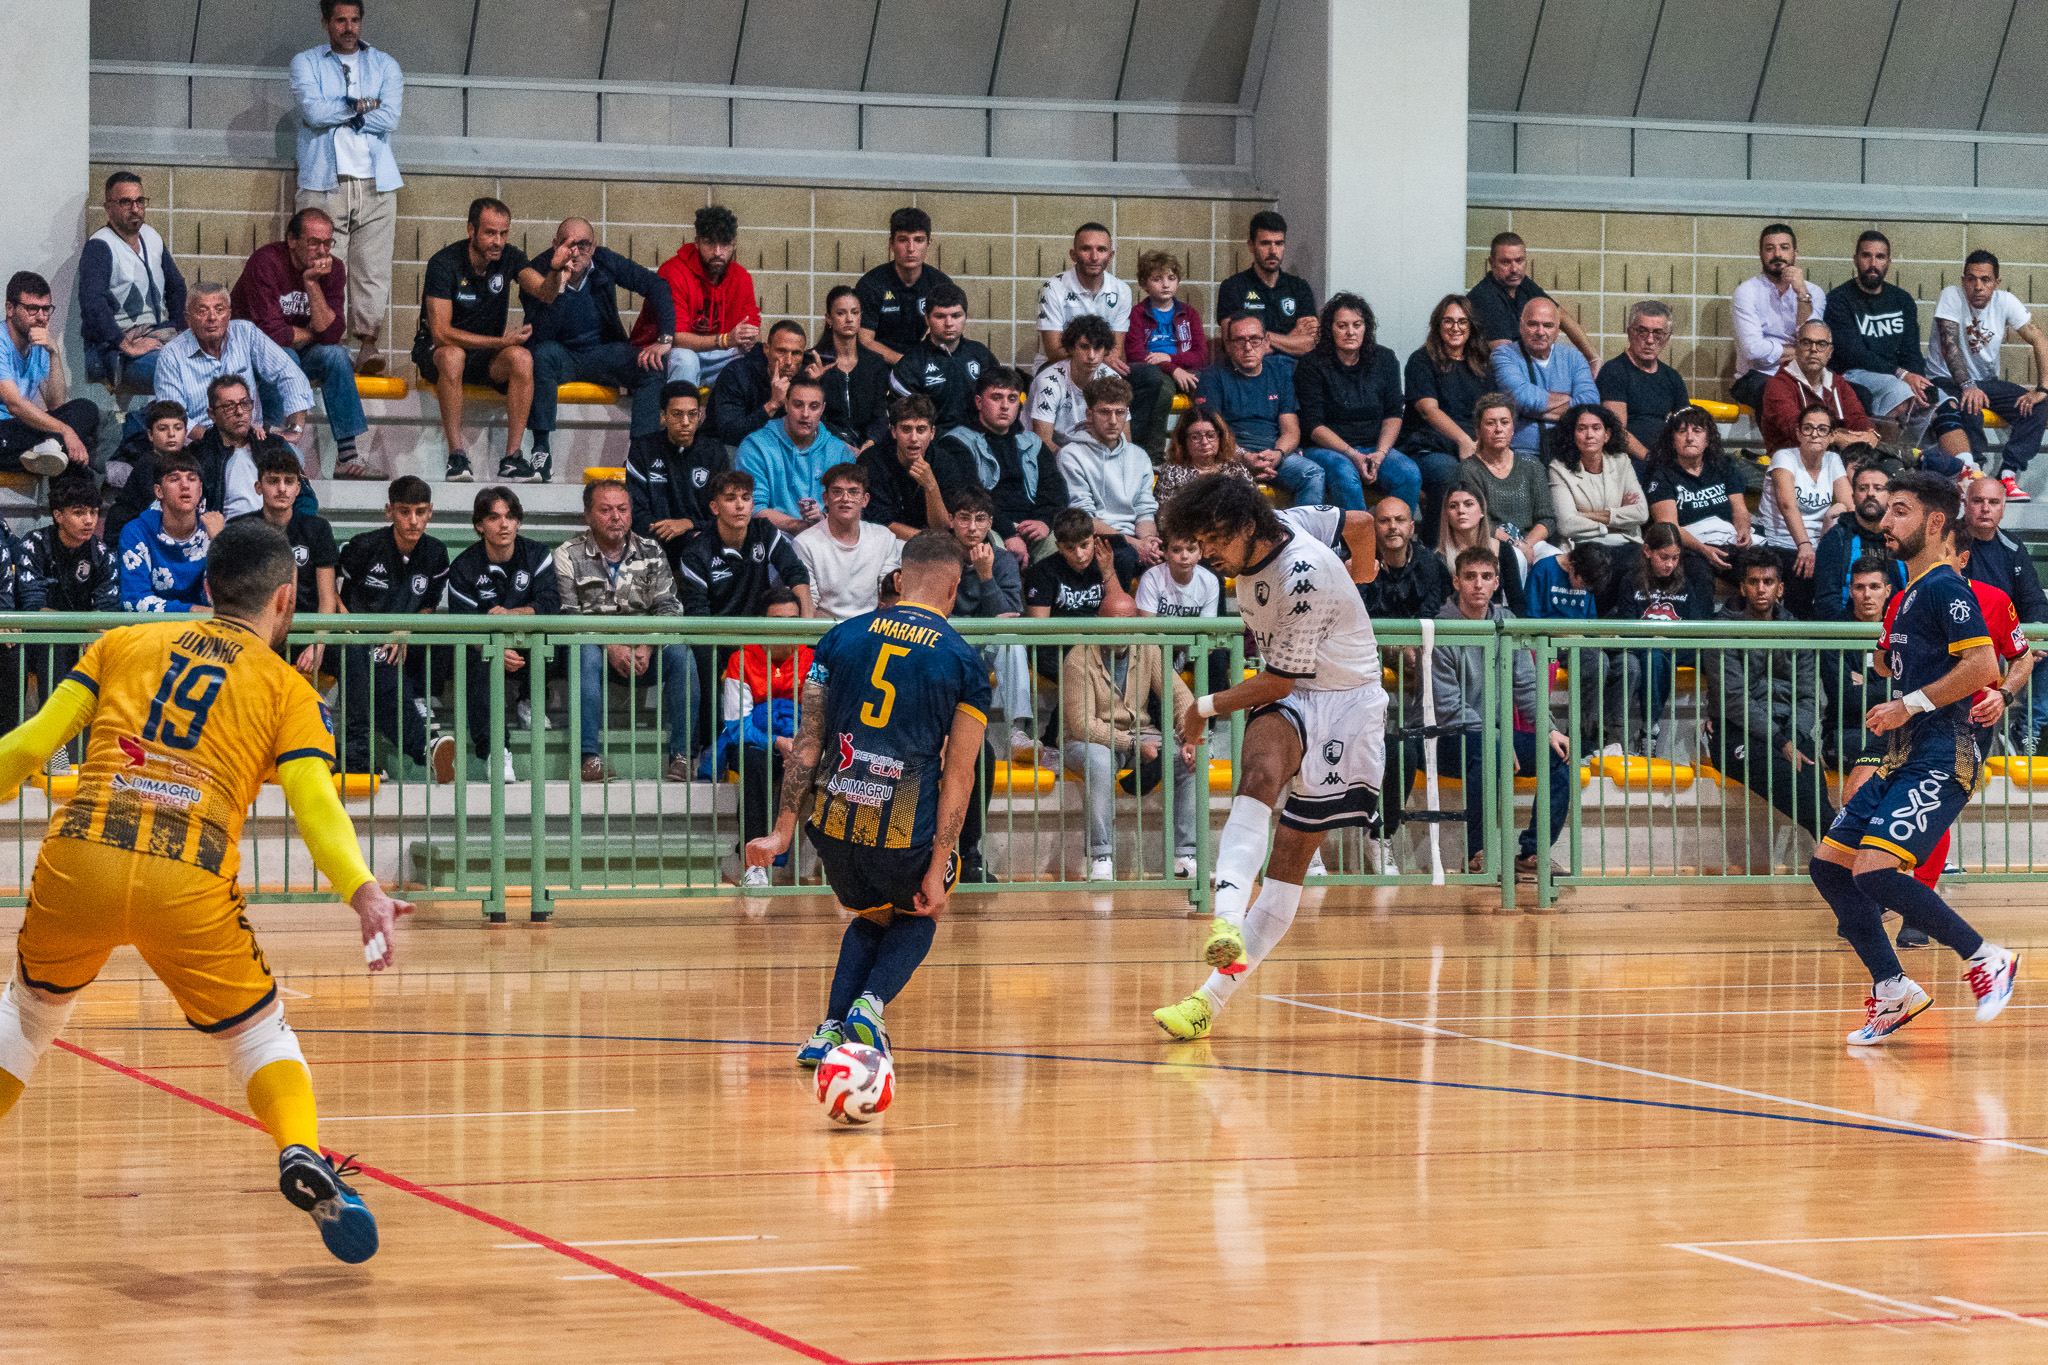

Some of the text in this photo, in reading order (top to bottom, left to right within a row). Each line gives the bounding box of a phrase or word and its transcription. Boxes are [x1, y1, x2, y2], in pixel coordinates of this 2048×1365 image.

[1855, 311, 1905, 338] VANS
[1692, 494, 1729, 508] DES RUES
[868, 617, 943, 648] AMARANTE
[171, 630, 244, 664] JUNINHO
[860, 642, 911, 728] 5
[142, 650, 226, 750] 19
[853, 749, 904, 771] DEFINITIVE
[870, 763, 902, 780] CLM
[131, 776, 201, 802] DIMAGRU
[139, 790, 189, 808] SERVICE
[840, 777, 893, 801] DIMAGRU
[845, 793, 881, 808] SERVICE
